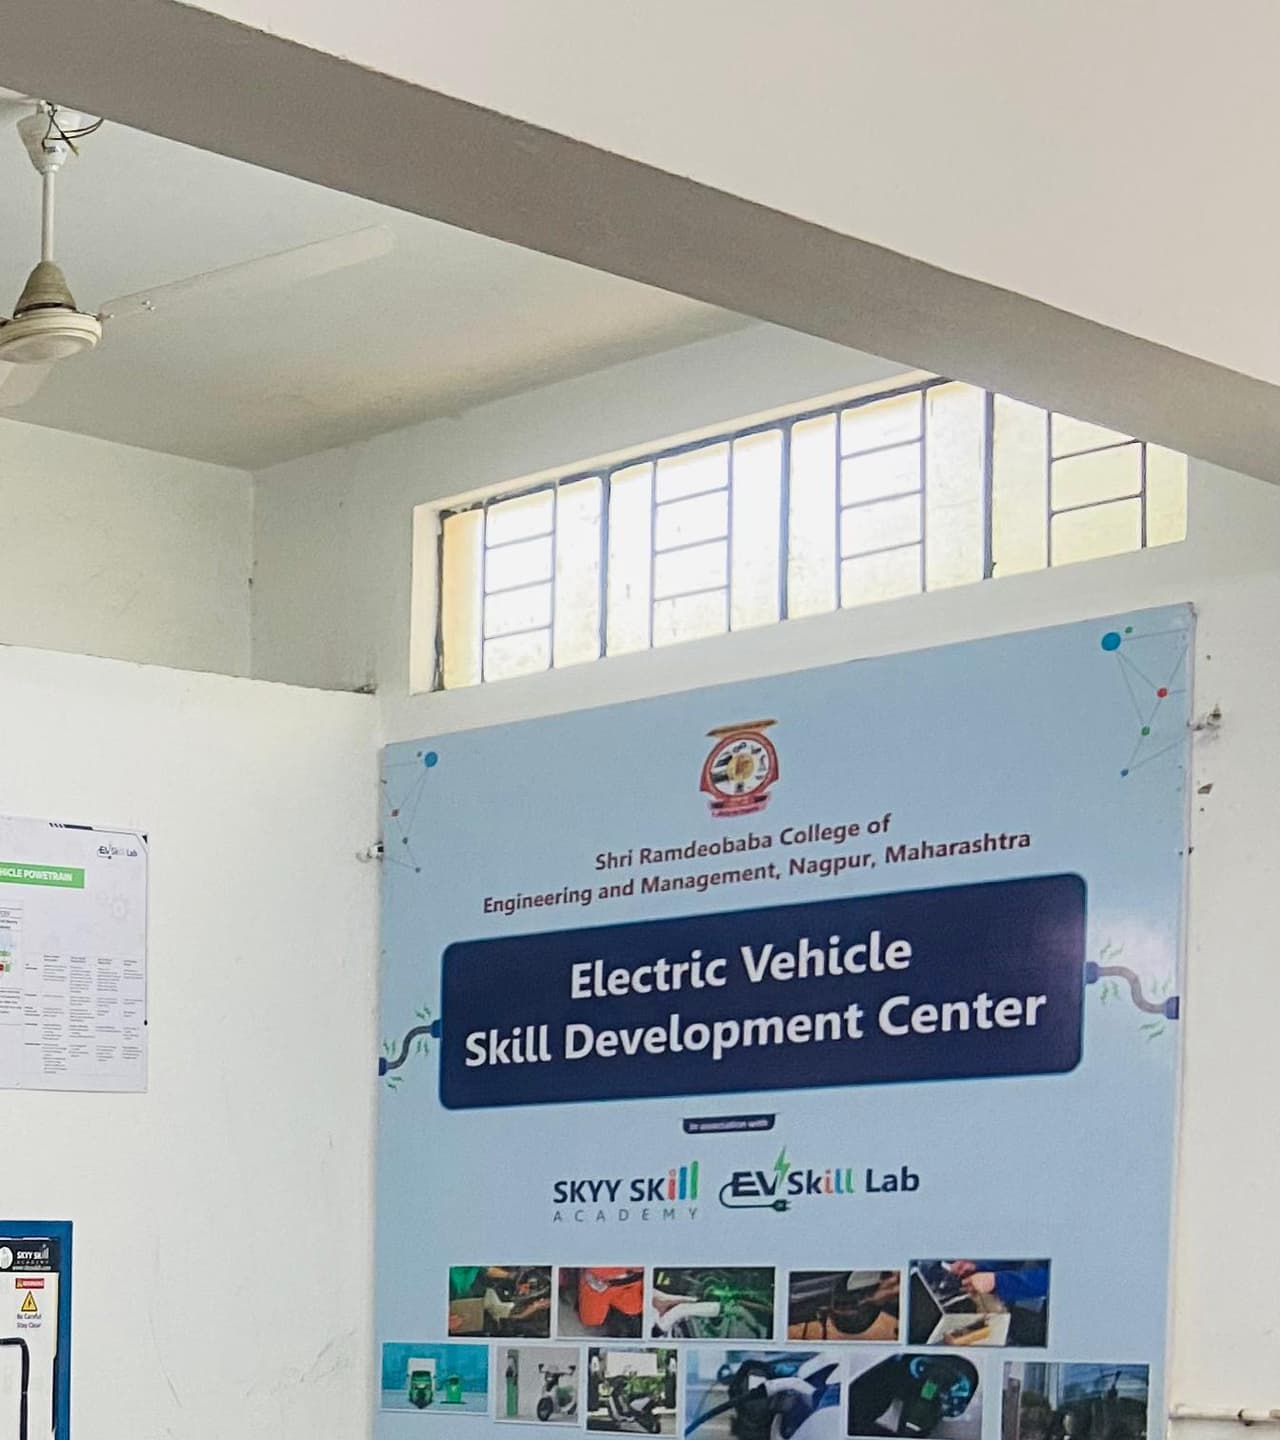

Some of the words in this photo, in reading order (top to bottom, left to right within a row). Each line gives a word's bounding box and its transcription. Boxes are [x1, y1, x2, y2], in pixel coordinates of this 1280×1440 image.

[595, 848, 635, 871] Shri
[640, 832, 773, 865] Ramdeobaba
[779, 823, 861, 846] College
[867, 814, 892, 835] of
[483, 888, 593, 916] Engineering
[599, 881, 634, 900] and
[640, 864, 781, 895] Management,
[789, 856, 876, 879] Nagpur,
[884, 835, 1031, 866] Maharashtra
[571, 951, 728, 998] Electric
[741, 934, 913, 982] Vehicle
[465, 1027, 552, 1068] Skill
[564, 1005, 863, 1060] Development
[879, 996, 1046, 1037] Center
[553, 1179, 621, 1204] SKYY
[731, 1171, 779, 1197] EV
[788, 1169, 855, 1196] Skill
[865, 1166, 920, 1194] Lab
